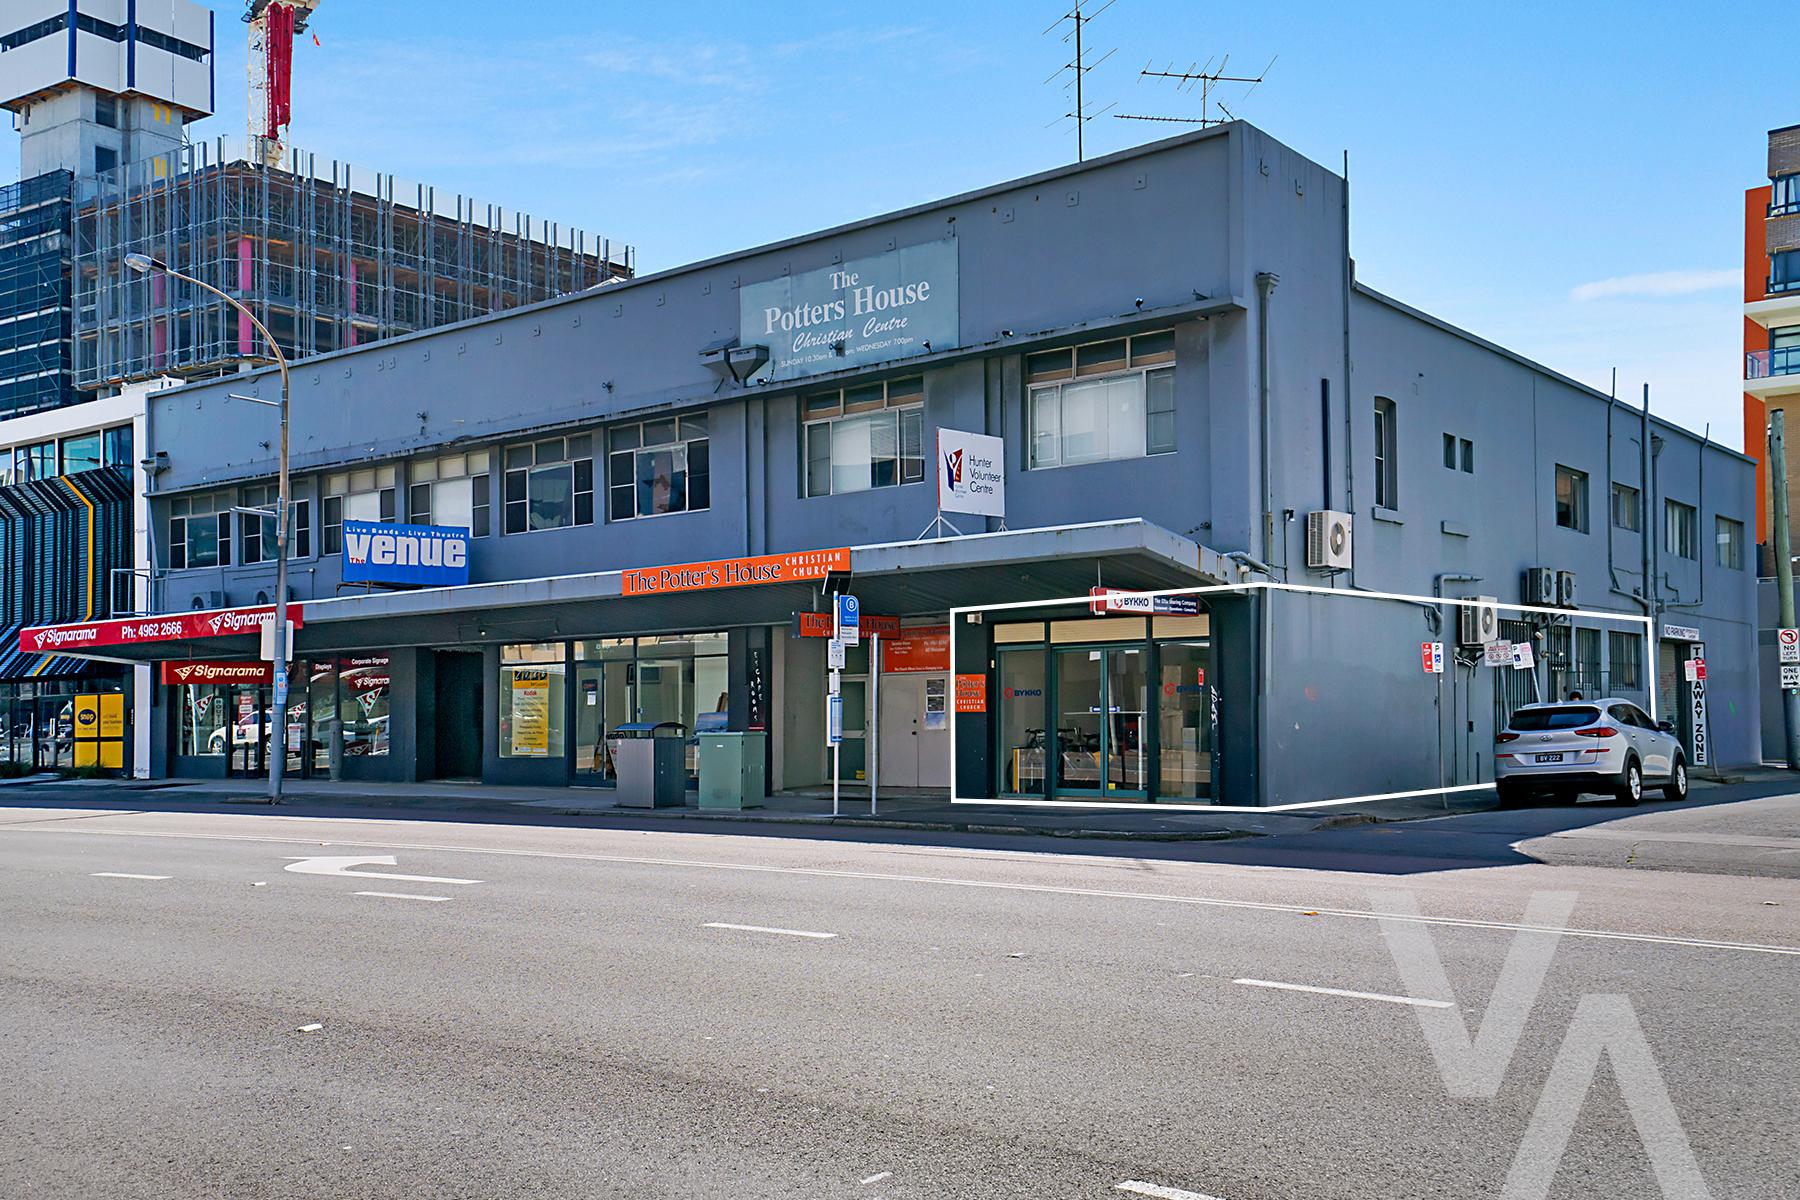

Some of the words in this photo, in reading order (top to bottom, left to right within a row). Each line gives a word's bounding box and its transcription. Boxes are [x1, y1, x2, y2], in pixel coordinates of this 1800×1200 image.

[829, 271, 860, 291] The
[764, 299, 845, 335] Potters
[853, 281, 930, 316] House
[792, 328, 854, 353] Christian
[863, 316, 909, 338] Centre
[779, 357, 804, 368] SUNDAY
[856, 341, 892, 353] WEDNESDAY
[969, 455, 992, 468] Hunter
[969, 468, 1001, 482] Volunteer
[969, 481, 993, 494] Centre
[431, 531, 465, 539] Theatre
[785, 552, 841, 566] CHRISTIAN
[626, 571, 657, 593] The
[660, 566, 720, 589] Potter's
[725, 563, 782, 583] House
[849, 600, 855, 609] B
[1124, 597, 1149, 607] BYKKO
[223, 612, 276, 628] Signaram
[805, 613, 825, 628] The
[46, 627, 97, 643] Signarama
[121, 625, 136, 639] Ph:
[138, 623, 159, 638] 4962
[161, 621, 182, 636] 2666
[194, 665, 265, 679] Signarama
[1014, 689, 1042, 697] BYKKO
[1692, 681, 1704, 720] AWAY
[1695, 724, 1705, 762] ZONE
